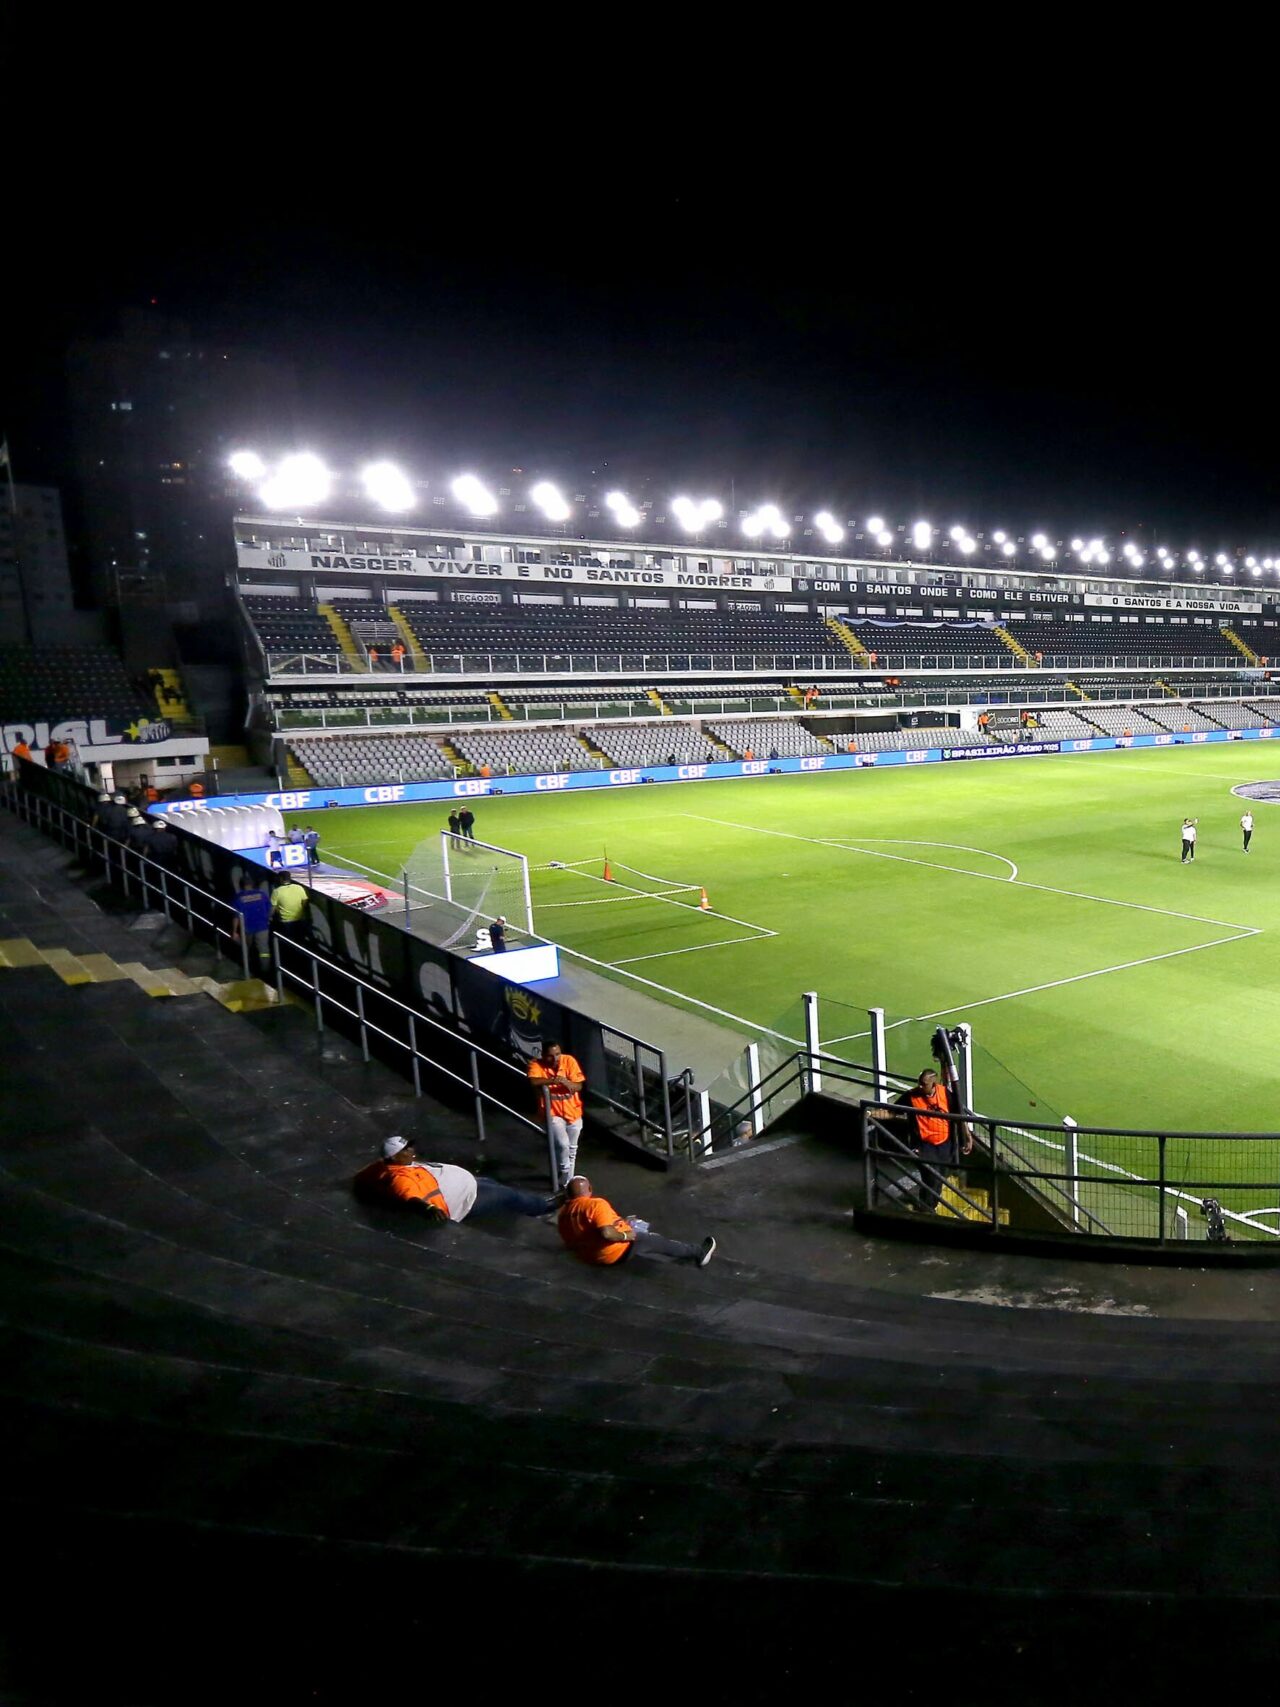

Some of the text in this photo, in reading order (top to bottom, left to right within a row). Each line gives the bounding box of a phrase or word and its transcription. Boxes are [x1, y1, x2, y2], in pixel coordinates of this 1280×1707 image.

[311, 555, 752, 588] NASCER, VIVER E NO SANTOS MORRER
[814, 581, 1069, 603] COM O SANTOS ONDE E COMO ELE ESTIVER
[1124, 598, 1162, 607] SANTOS
[1175, 600, 1182, 608] A
[1186, 601, 1215, 610] NOSSA
[1219, 602, 1241, 611] VIDA
[0, 720, 124, 751] DIAL
[1116, 736, 1134, 745] CBF
[1155, 734, 1172, 743] CBF
[1192, 732, 1208, 741] CBF
[1227, 730, 1242, 738] CBF
[1073, 739, 1093, 749] CBF
[906, 750, 928, 762] CBF
[952, 744, 1017, 758] BRASILEIRÃO
[800, 757, 825, 770] CBF
[855, 752, 878, 765] CBF
[678, 765, 708, 778] CBF
[742, 760, 768, 773] CBF
[535, 775, 568, 789] CBF
[610, 770, 640, 784] CBF
[364, 785, 404, 802] CBF
[454, 779, 491, 796] CBF
[266, 792, 310, 809] CBF
